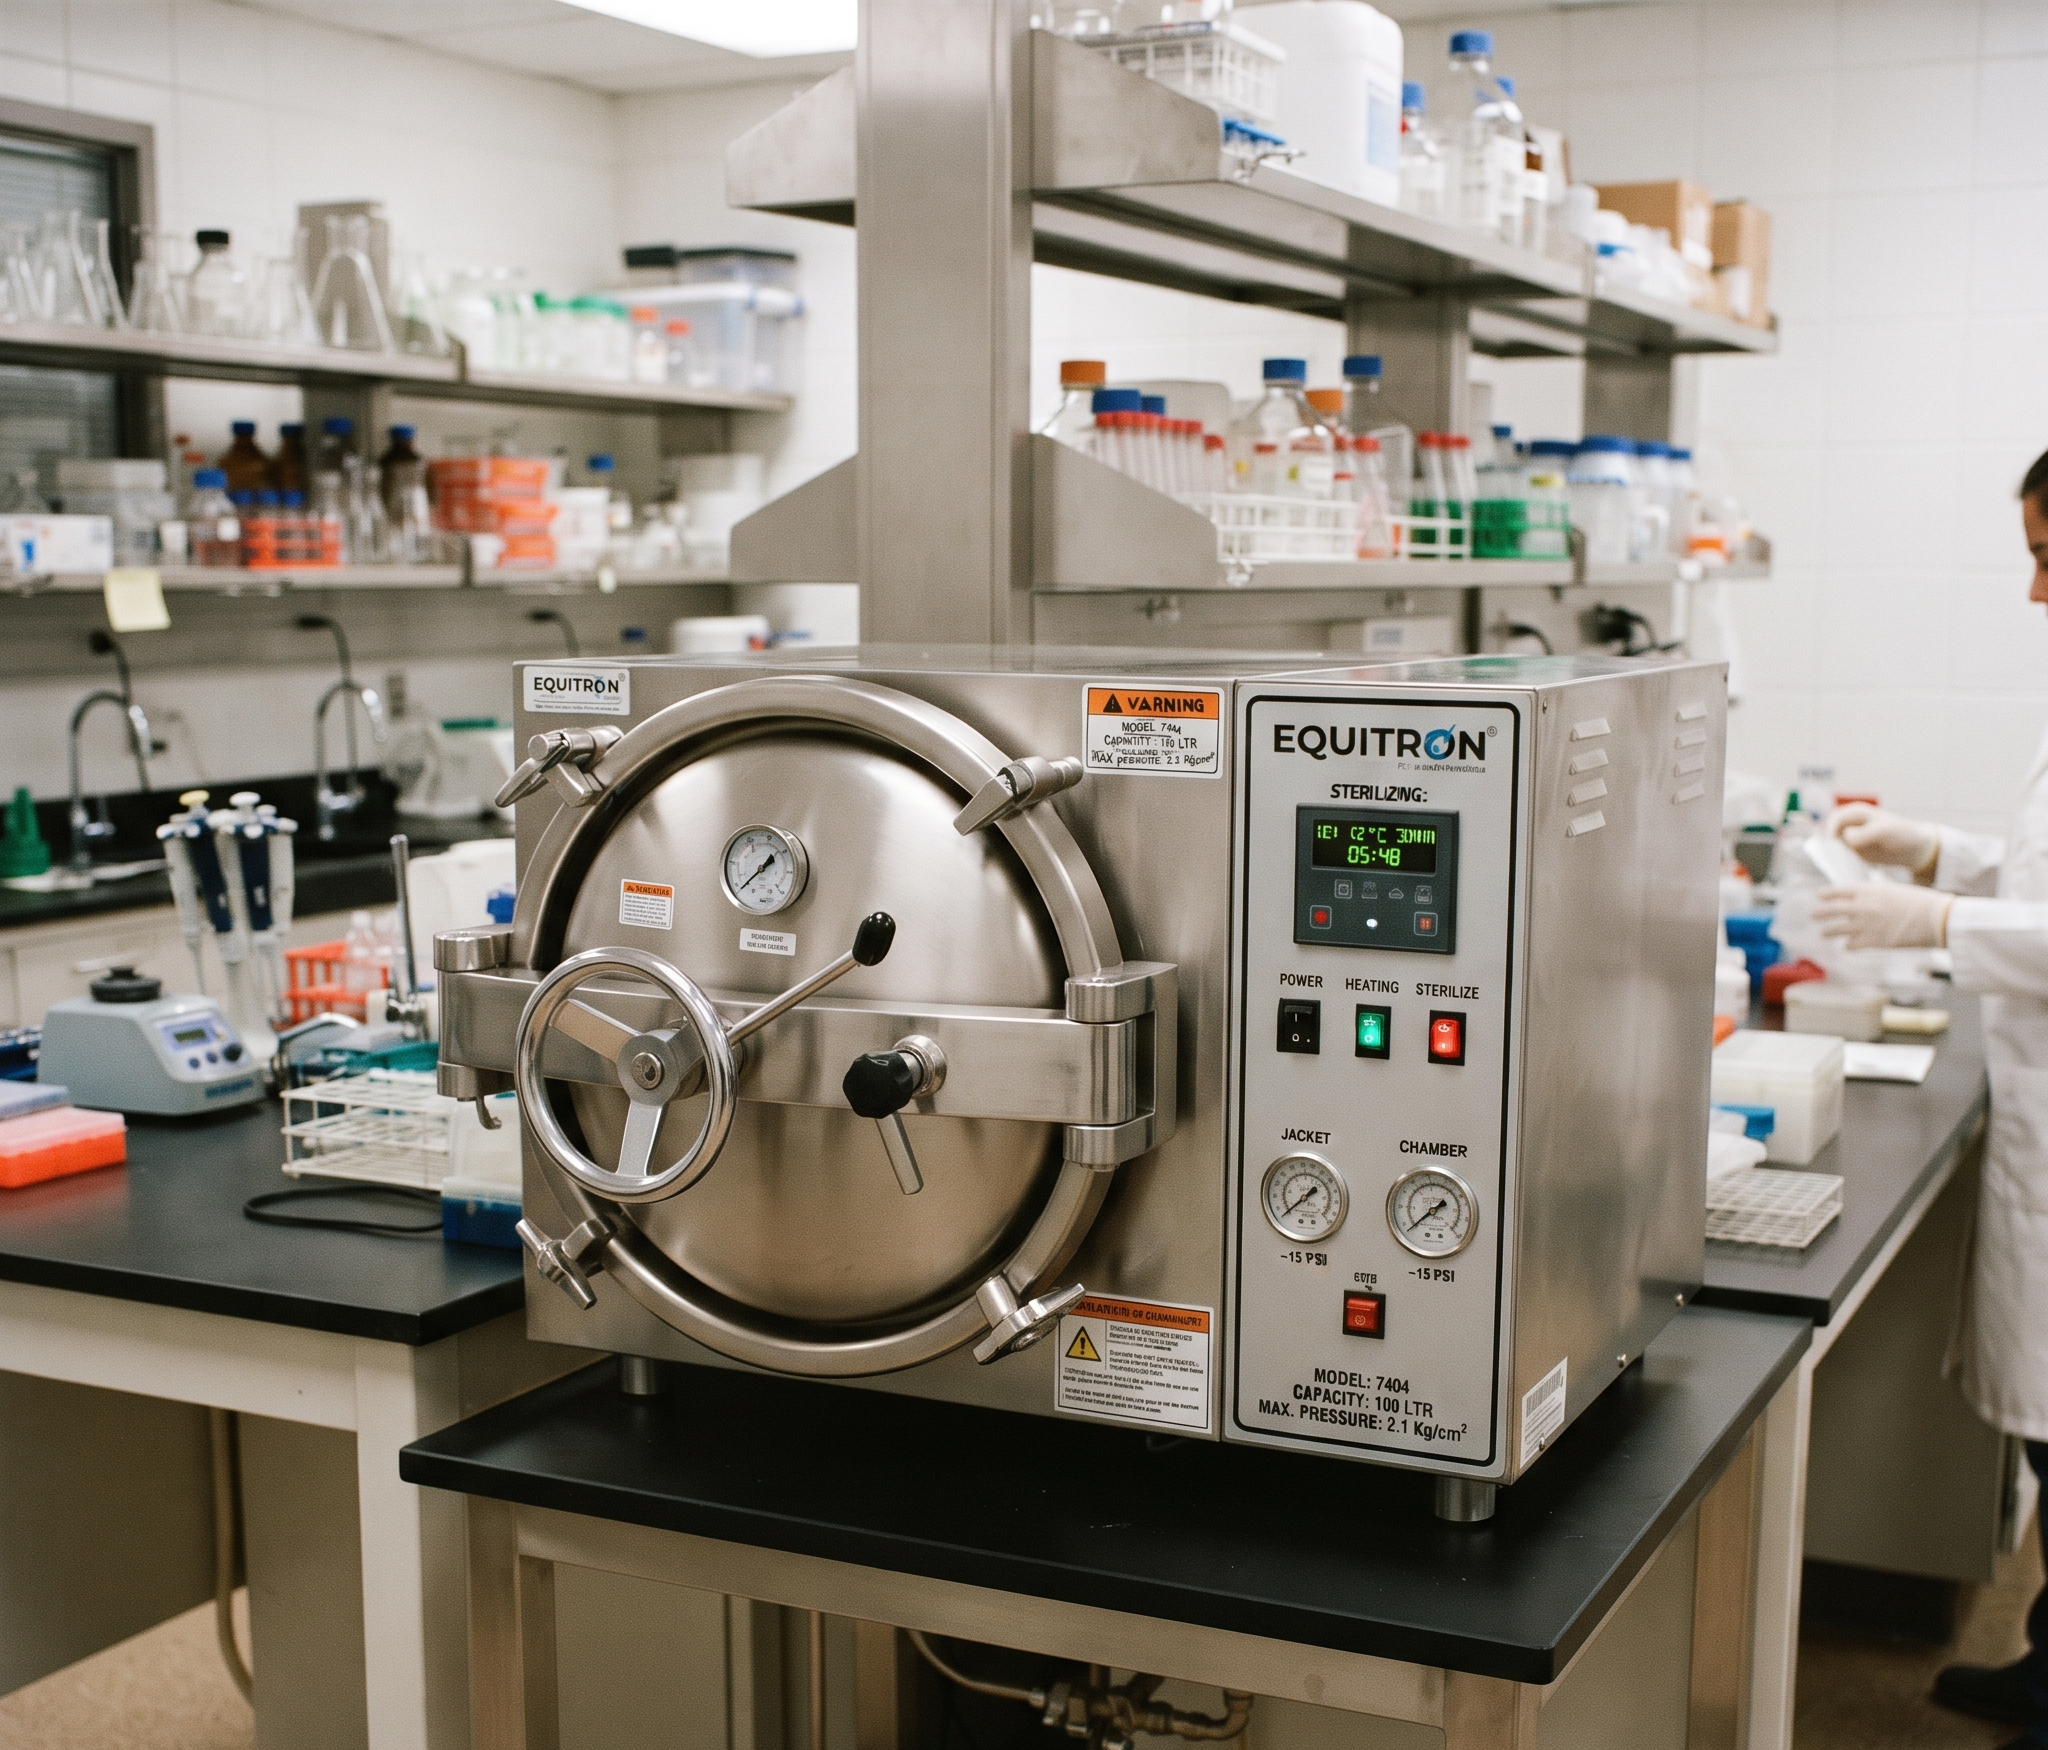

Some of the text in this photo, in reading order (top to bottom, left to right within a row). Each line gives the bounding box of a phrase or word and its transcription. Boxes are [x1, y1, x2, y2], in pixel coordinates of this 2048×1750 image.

[534, 677, 619, 694] EQUITRON
[1273, 724, 1486, 761] EQUITRON
[1347, 845, 1401, 867] 05:48
[1279, 973, 1324, 988] POWER
[1345, 978, 1400, 994] HEATING
[1415, 982, 1480, 1000] STERILIZE
[1281, 1127, 1331, 1145] JACKET
[1399, 1139, 1468, 1158] CHAMBER
[1433, 1268, 1455, 1283] PSI
[1314, 1367, 1410, 1395] MODEL: 7404
[1293, 1383, 1434, 1419] CAPACITY: 100 LTR
[1258, 1399, 1295, 1418] MAX.
[1300, 1404, 1382, 1431] PRESSURE:
[1387, 1416, 1408, 1434] 2.1
